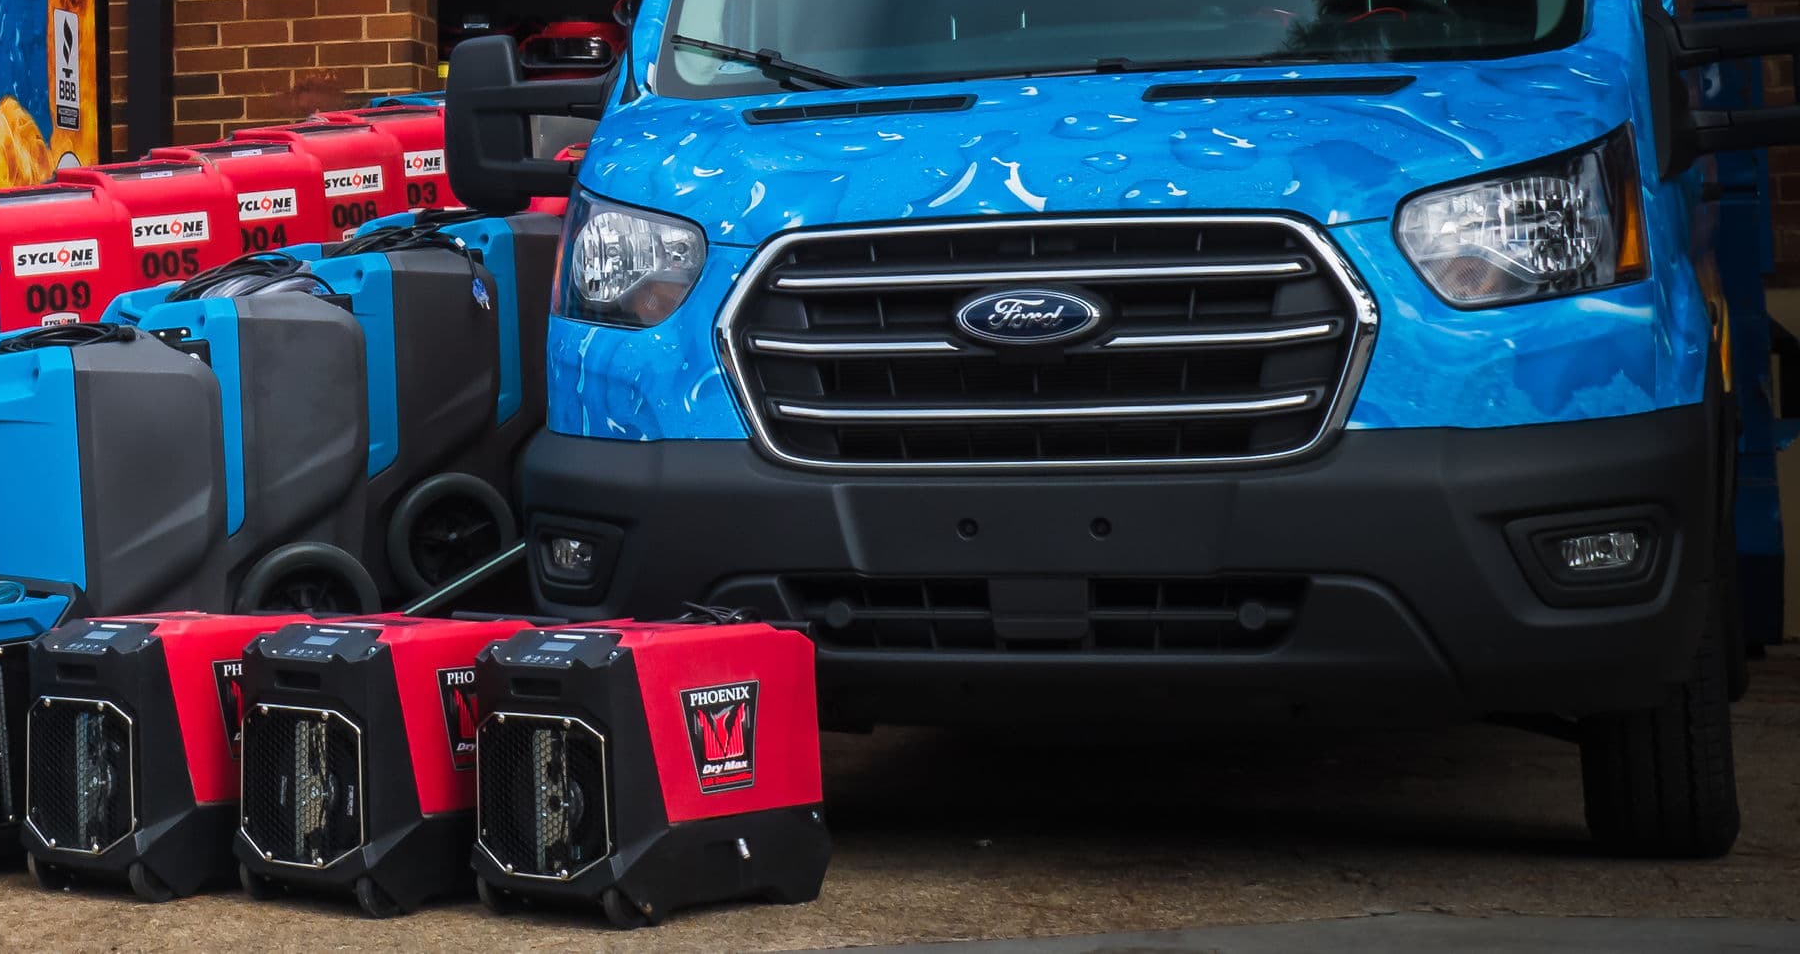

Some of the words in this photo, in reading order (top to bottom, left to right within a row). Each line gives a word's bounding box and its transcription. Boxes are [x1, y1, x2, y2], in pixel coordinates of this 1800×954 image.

[59, 80, 77, 102] BBB
[406, 155, 441, 171] LONE
[324, 172, 379, 189] SYCLONE
[407, 180, 437, 206] 03
[238, 196, 292, 213] YCLONE
[134, 219, 204, 238] SYCLONE
[17, 246, 94, 267] SYCLONE
[142, 247, 200, 280] 005
[26, 280, 91, 314] 009
[987, 298, 1064, 330] Ford
[690, 686, 750, 706] PHOENIX
[702, 763, 724, 775] Dry
[723, 760, 748, 771] Max
